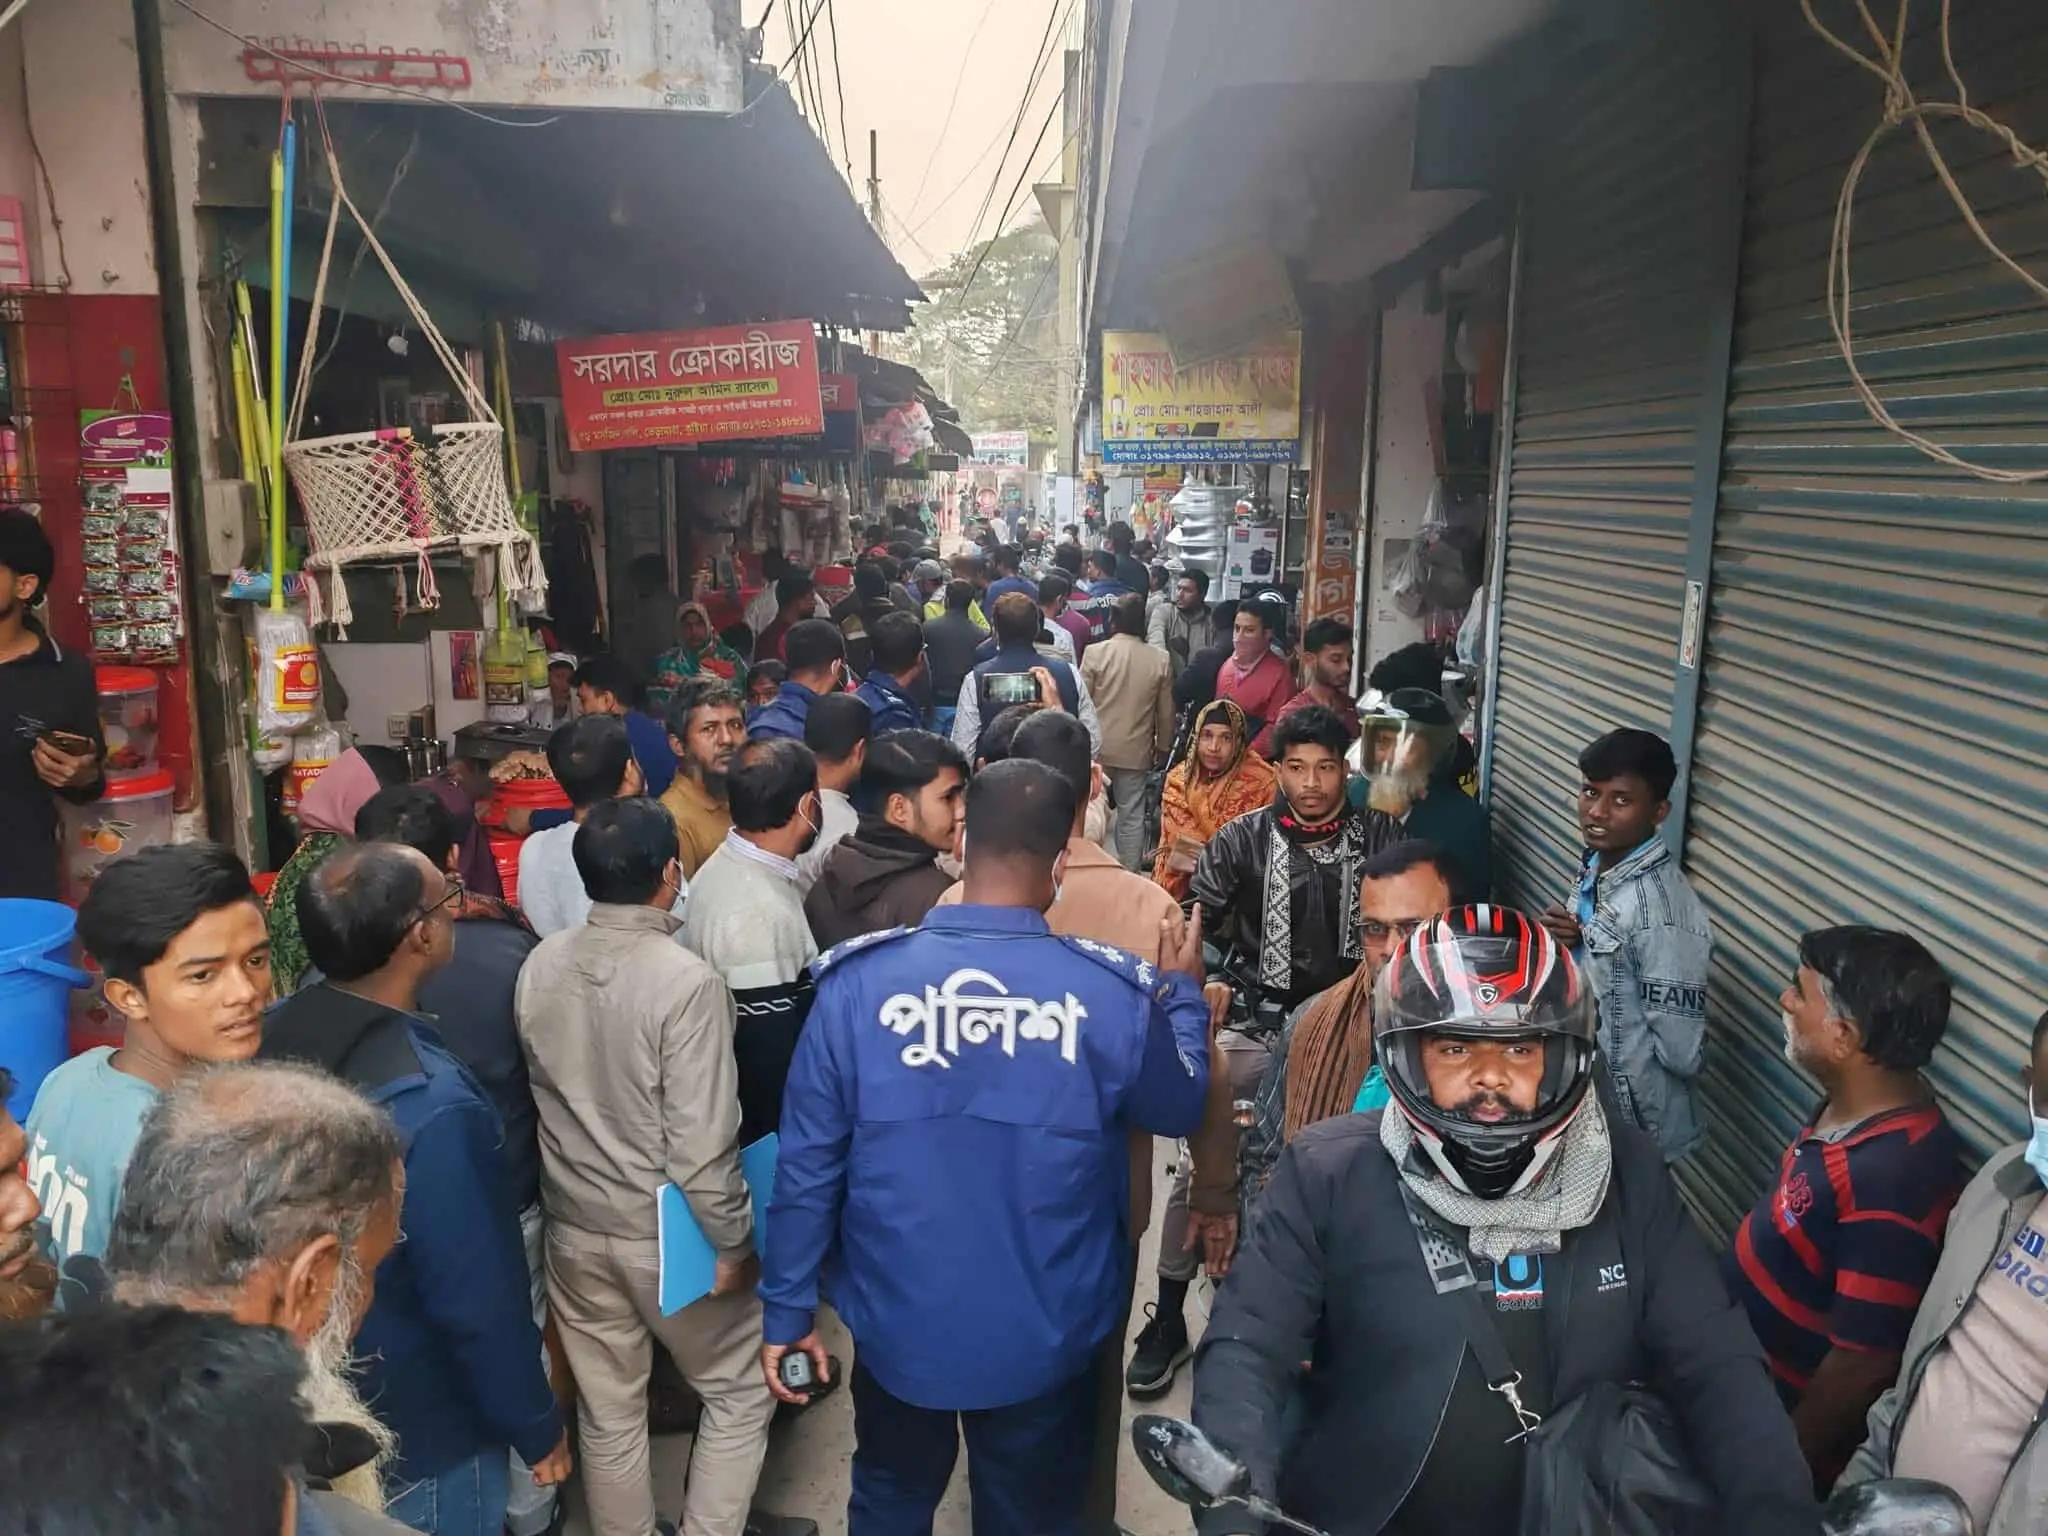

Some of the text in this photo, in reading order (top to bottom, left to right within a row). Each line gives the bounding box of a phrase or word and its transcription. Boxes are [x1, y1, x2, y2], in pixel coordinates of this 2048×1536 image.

[569, 330, 801, 384] সরদার ক্রোকারীজ
[638, 389, 660, 402] মোঃ
[700, 383, 731, 399] আমিন
[734, 380, 770, 394] রাসেল
[1159, 404, 1180, 418] মোঃ
[1184, 403, 1234, 417] শাহজাহান
[1238, 401, 1262, 417] আলী
[1640, 982, 1706, 1010] JEANS
[879, 968, 1088, 1068] পুলিশ
